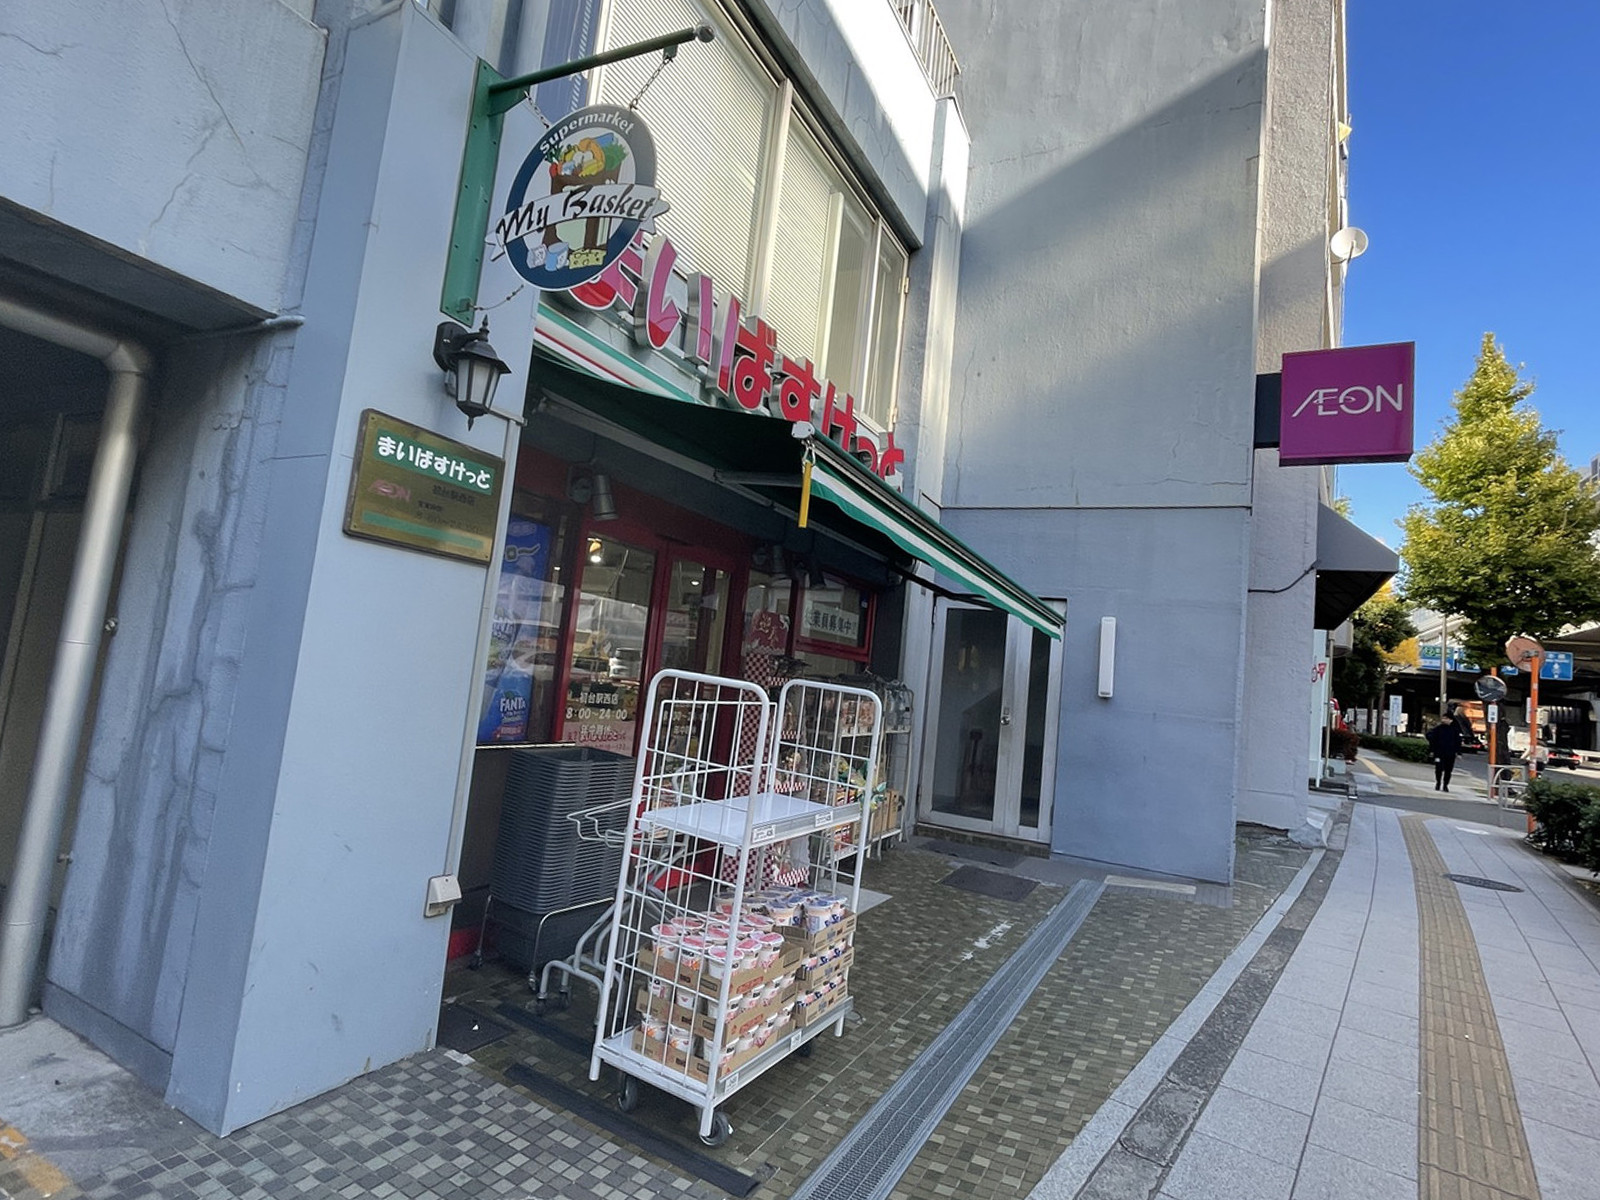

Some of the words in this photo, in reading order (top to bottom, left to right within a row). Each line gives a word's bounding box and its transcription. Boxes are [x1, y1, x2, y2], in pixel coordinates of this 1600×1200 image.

[540, 111, 635, 155] Supermarket
[495, 200, 550, 244] My
[562, 183, 655, 221] Basket
[377, 436, 491, 490] まいばすけっと
[500, 697, 526, 712] FANTA
